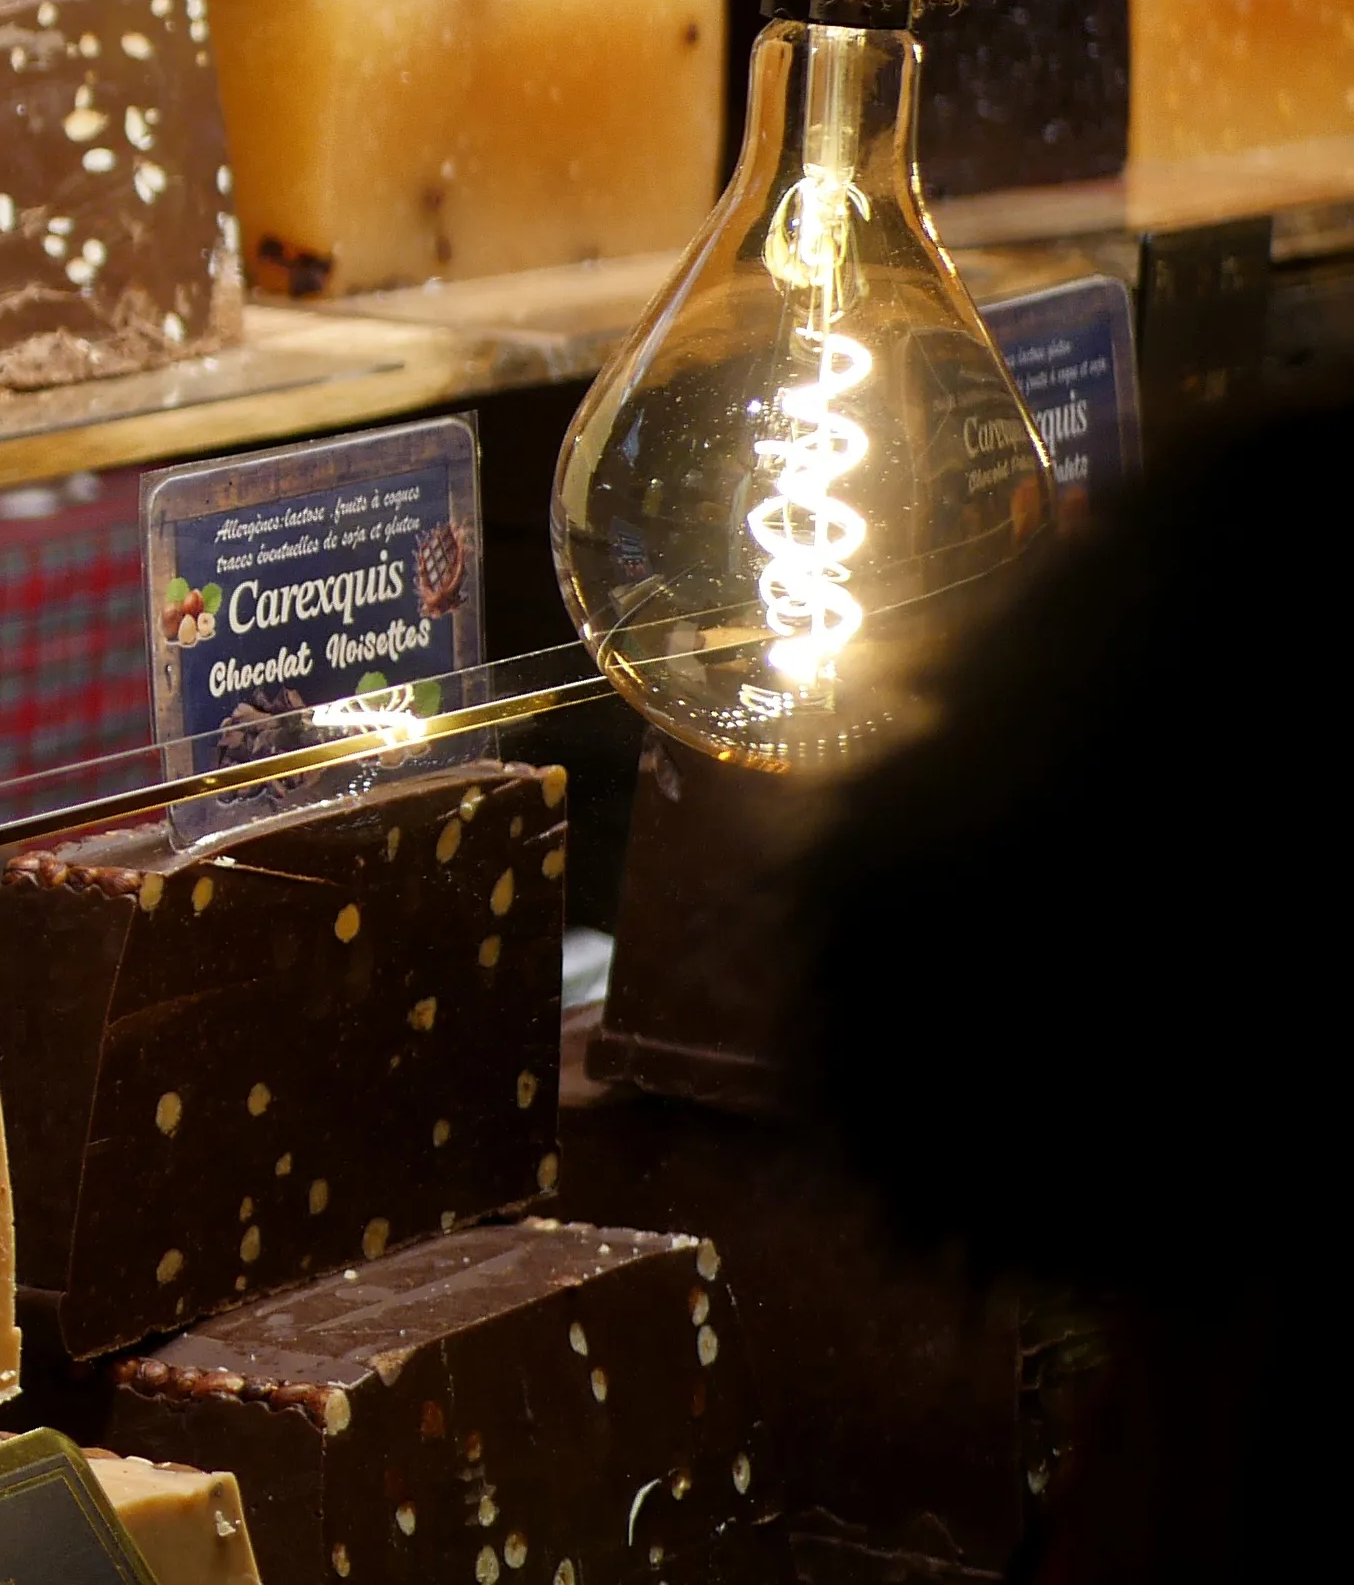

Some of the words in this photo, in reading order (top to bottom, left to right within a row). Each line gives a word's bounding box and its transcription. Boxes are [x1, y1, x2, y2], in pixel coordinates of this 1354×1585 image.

[371, 489, 380, 508] à
[383, 485, 420, 511] coques
[216, 552, 253, 574] traces
[257, 534, 319, 564] éventuelles
[323, 531, 338, 551] de
[341, 525, 366, 550] soja
[370, 521, 382, 540] et
[384, 515, 421, 543] gluten
[228, 549, 404, 635] Carexquis
[208, 641, 313, 698] Chocolat
[325, 618, 432, 669] Noisettes
